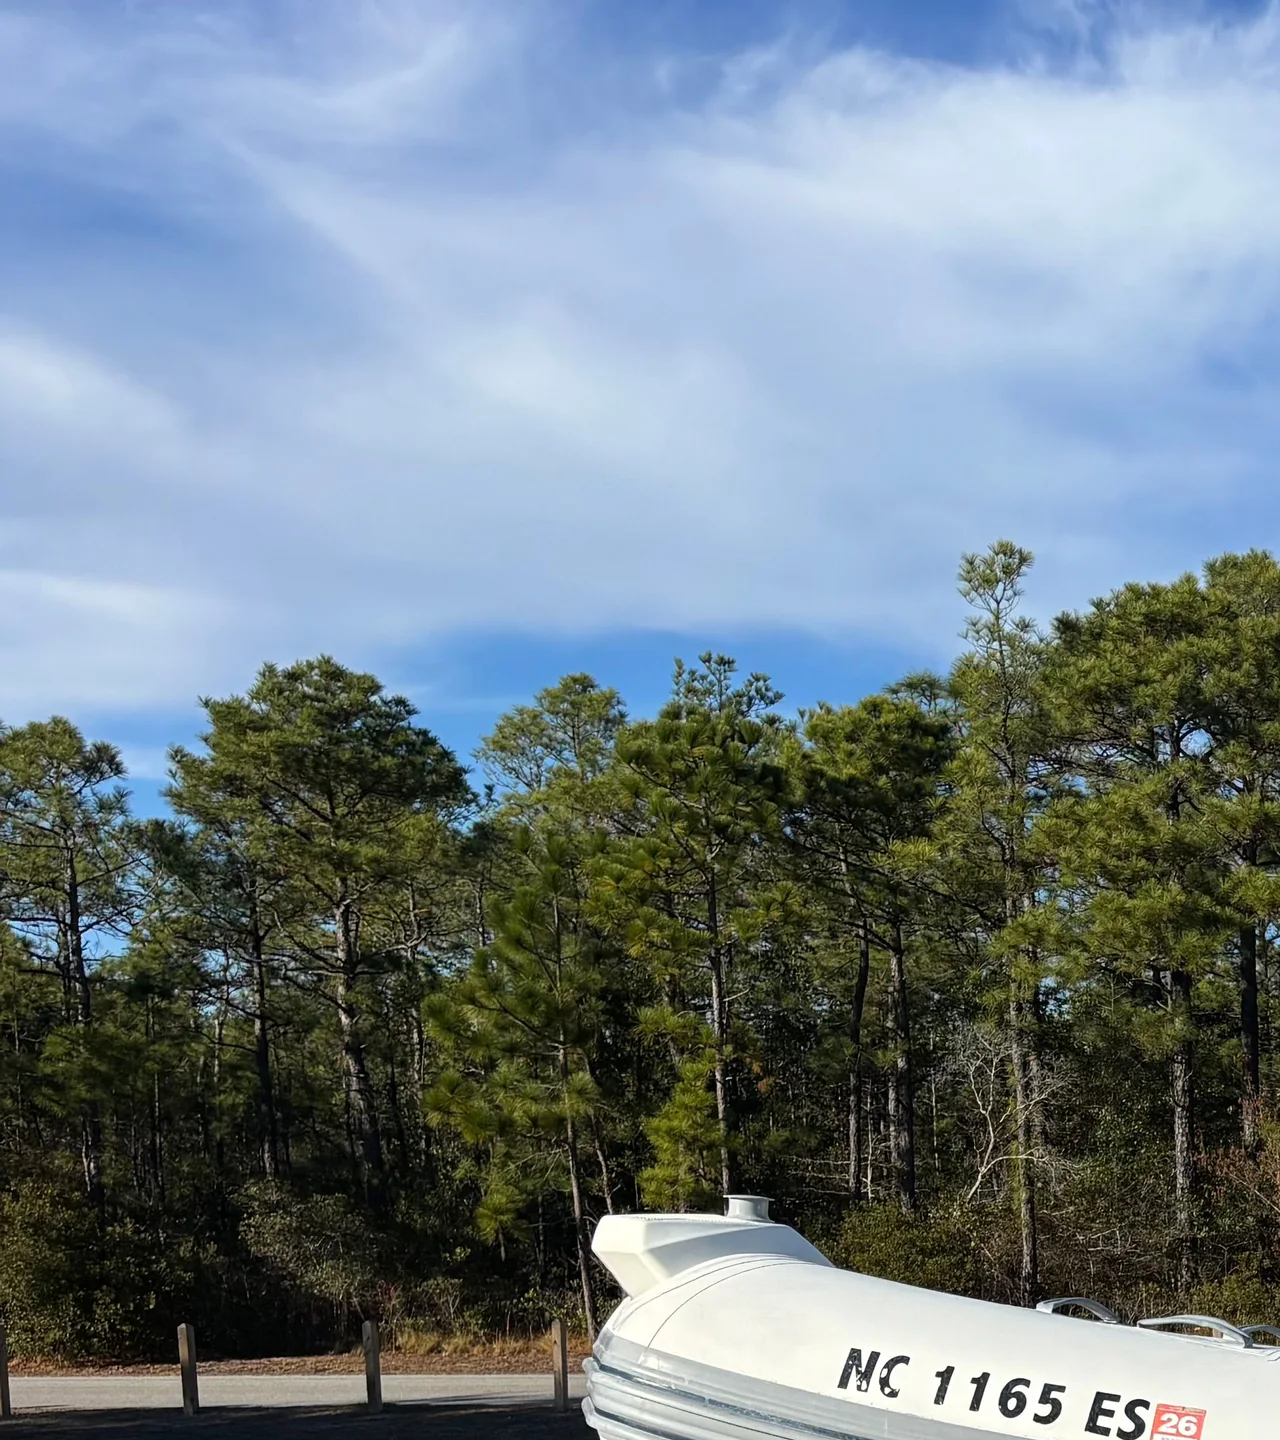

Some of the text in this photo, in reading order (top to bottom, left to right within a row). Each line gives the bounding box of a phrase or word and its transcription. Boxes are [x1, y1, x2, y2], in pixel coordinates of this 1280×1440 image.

[837, 1347, 1151, 1440] NC 1165 ES
[1157, 1412, 1199, 1437] 26
